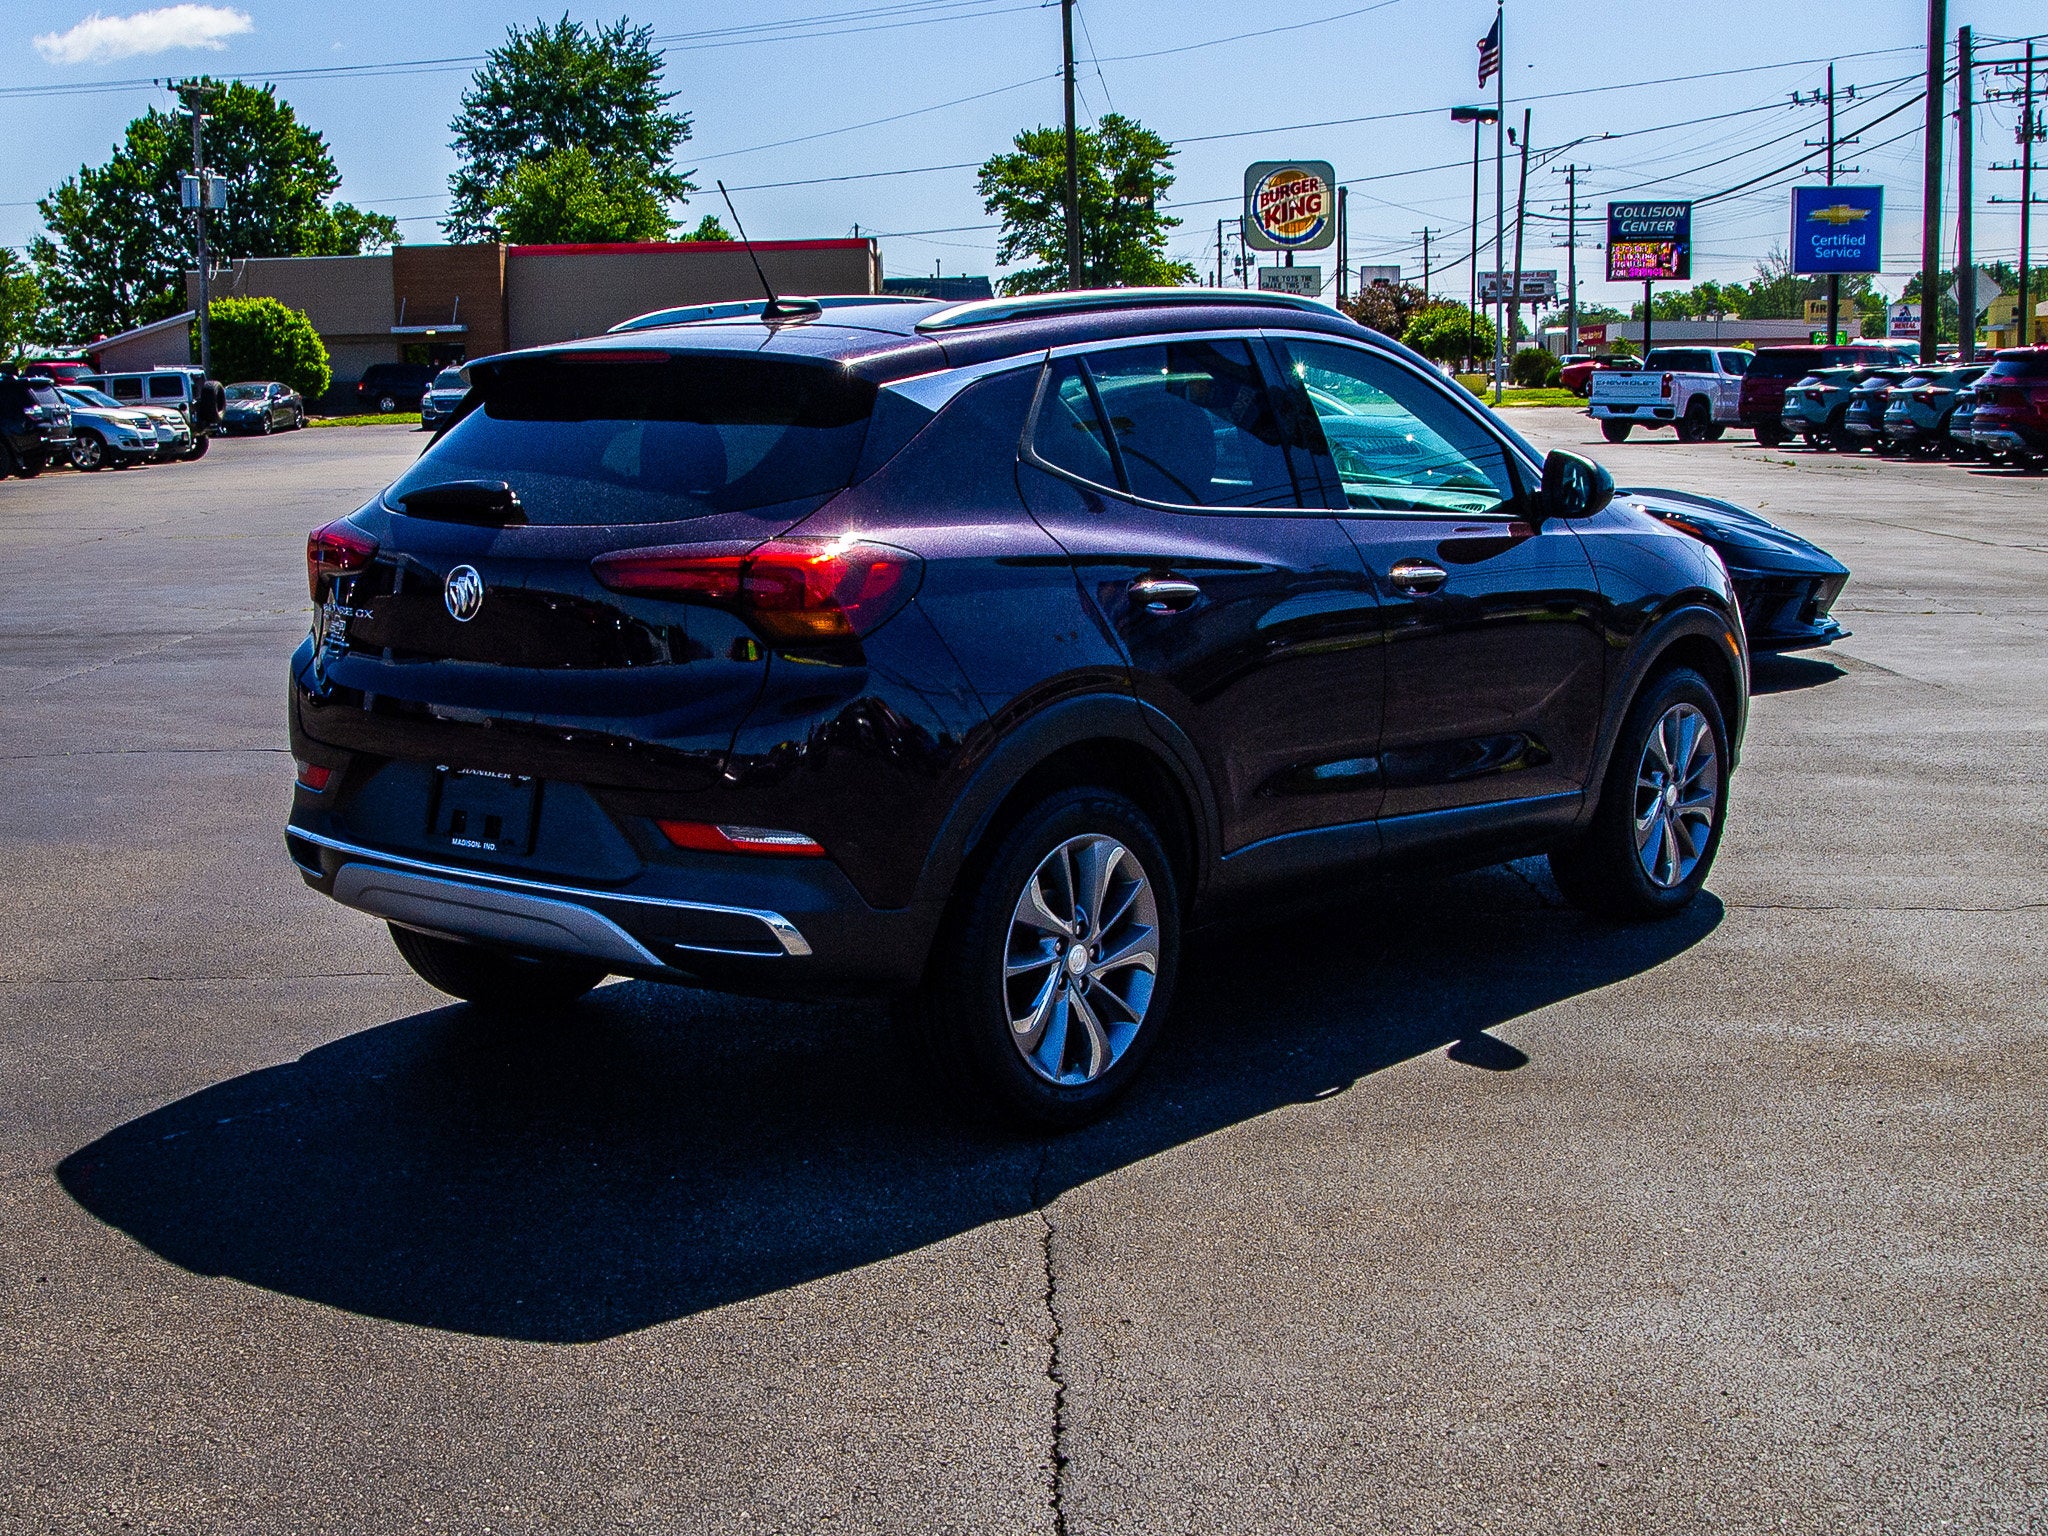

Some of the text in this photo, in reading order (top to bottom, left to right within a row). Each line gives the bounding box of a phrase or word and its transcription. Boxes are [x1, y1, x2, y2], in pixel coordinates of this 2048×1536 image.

[1260, 178, 1319, 208] BURGER
[1264, 193, 1322, 229] KING
[1613, 206, 1686, 218] COLLISION
[1620, 220, 1675, 232] CENTER
[1811, 234, 1866, 246] Certified
[1815, 247, 1861, 258] Service
[355, 608, 374, 620] GX
